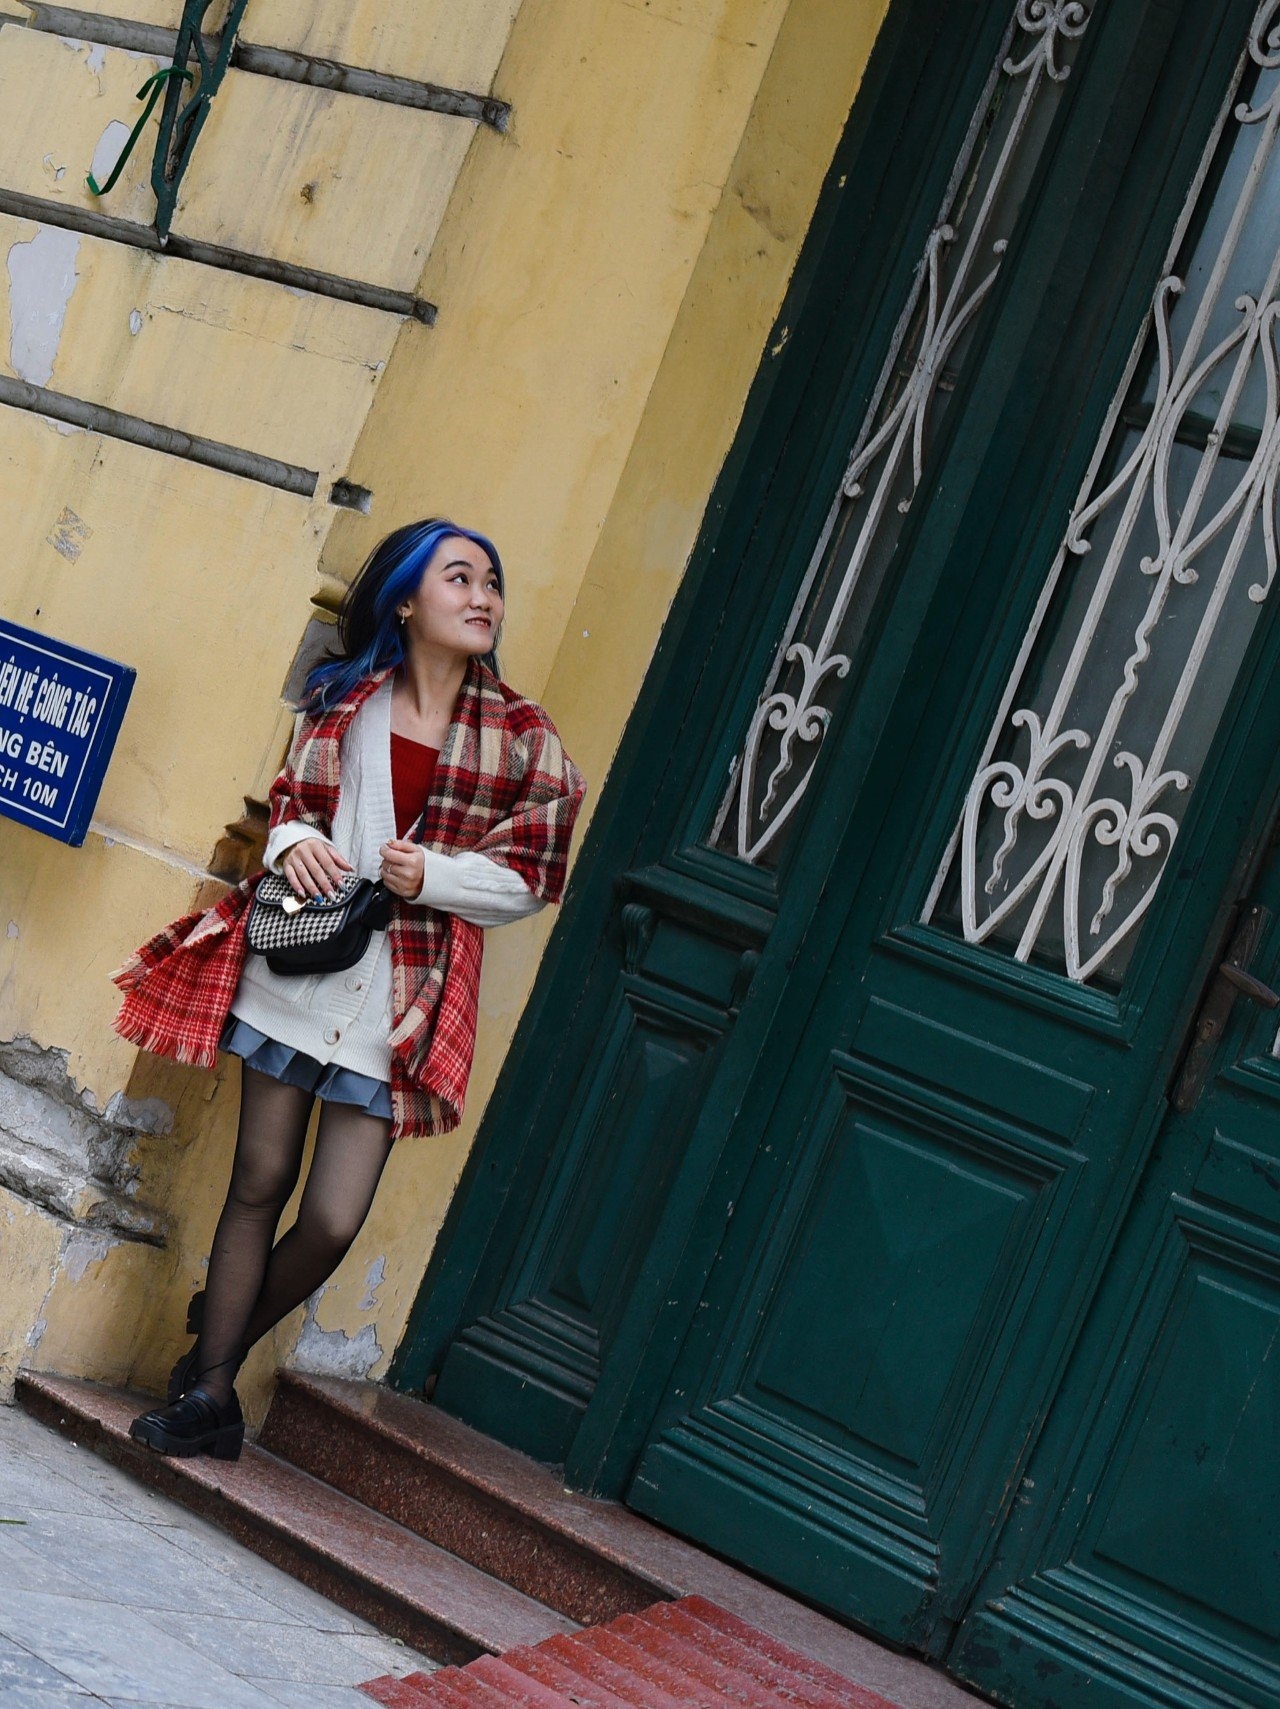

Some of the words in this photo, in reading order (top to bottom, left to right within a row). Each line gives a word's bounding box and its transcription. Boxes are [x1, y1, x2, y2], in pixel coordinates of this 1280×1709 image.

[14, 665, 41, 723] HỆ
[33, 672, 72, 729] CÔNG
[66, 686, 97, 739] TÁC
[25, 740, 70, 778] BÊN
[22, 777, 59, 809] 10M
